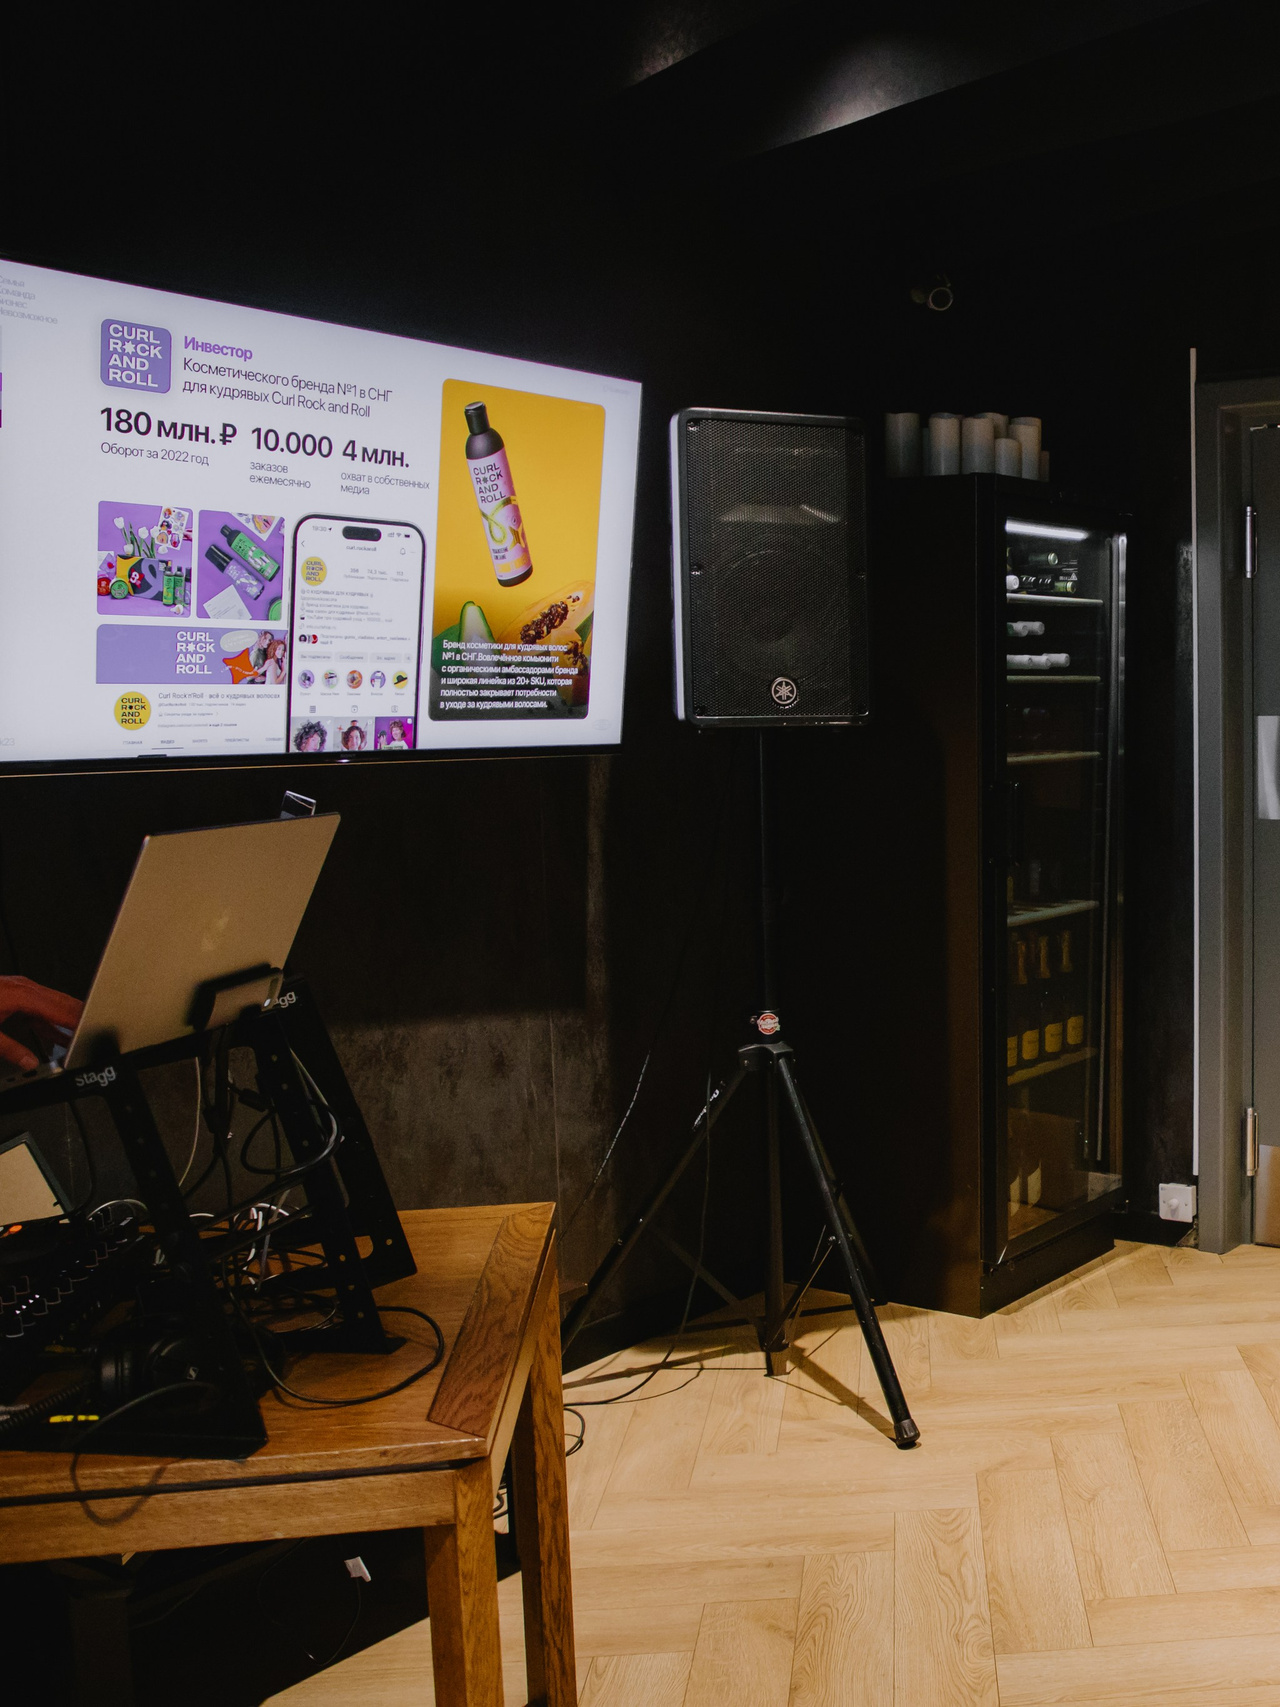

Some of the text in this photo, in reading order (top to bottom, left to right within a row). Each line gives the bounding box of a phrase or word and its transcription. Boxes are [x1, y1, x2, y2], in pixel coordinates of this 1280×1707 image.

[109, 324, 160, 344] CURL
[184, 336, 253, 361] Инвестор
[108, 354, 149, 371] AND
[109, 368, 159, 387] ROLL
[183, 357, 393, 402] Косметического бренда №1 в СНГ
[183, 381, 371, 417] для кудрявых Curl Rock and Roll
[100, 407, 152, 436] 180
[157, 420, 216, 444] млн.
[251, 427, 333, 458] 10.000
[101, 442, 210, 466] Оборот за 2022 год
[342, 439, 410, 468] 4 млн.
[250, 461, 289, 474] заказов
[473, 462, 500, 476] CURL
[249, 474, 312, 489] ежемесячно
[340, 472, 430, 490] охват в собственных
[340, 485, 370, 495] медиа
[479, 483, 499, 494] AND
[480, 491, 506, 503] ROLL
[176, 631, 214, 642] CURL
[443, 639, 466, 650] Бренд
[466, 642, 503, 650] косметики
[504, 643, 516, 651] для
[517, 644, 548, 652] кудрявых
[176, 653, 206, 663] AND
[176, 664, 212, 675] ROLL
[447, 665, 501, 674] органическими
[502, 665, 554, 675] амбассадорами
[555, 666, 579, 675] бренда
[447, 677, 478, 686] широкая
[478, 676, 506, 684] линейка
[516, 676, 530, 685] 20+
[547, 679, 573, 687] которая
[440, 688, 557, 698] полностью закрывает потребности
[445, 701, 466, 710] уходе
[476, 701, 514, 710] кудрявыми
[75, 1066, 117, 1087] Stagg
